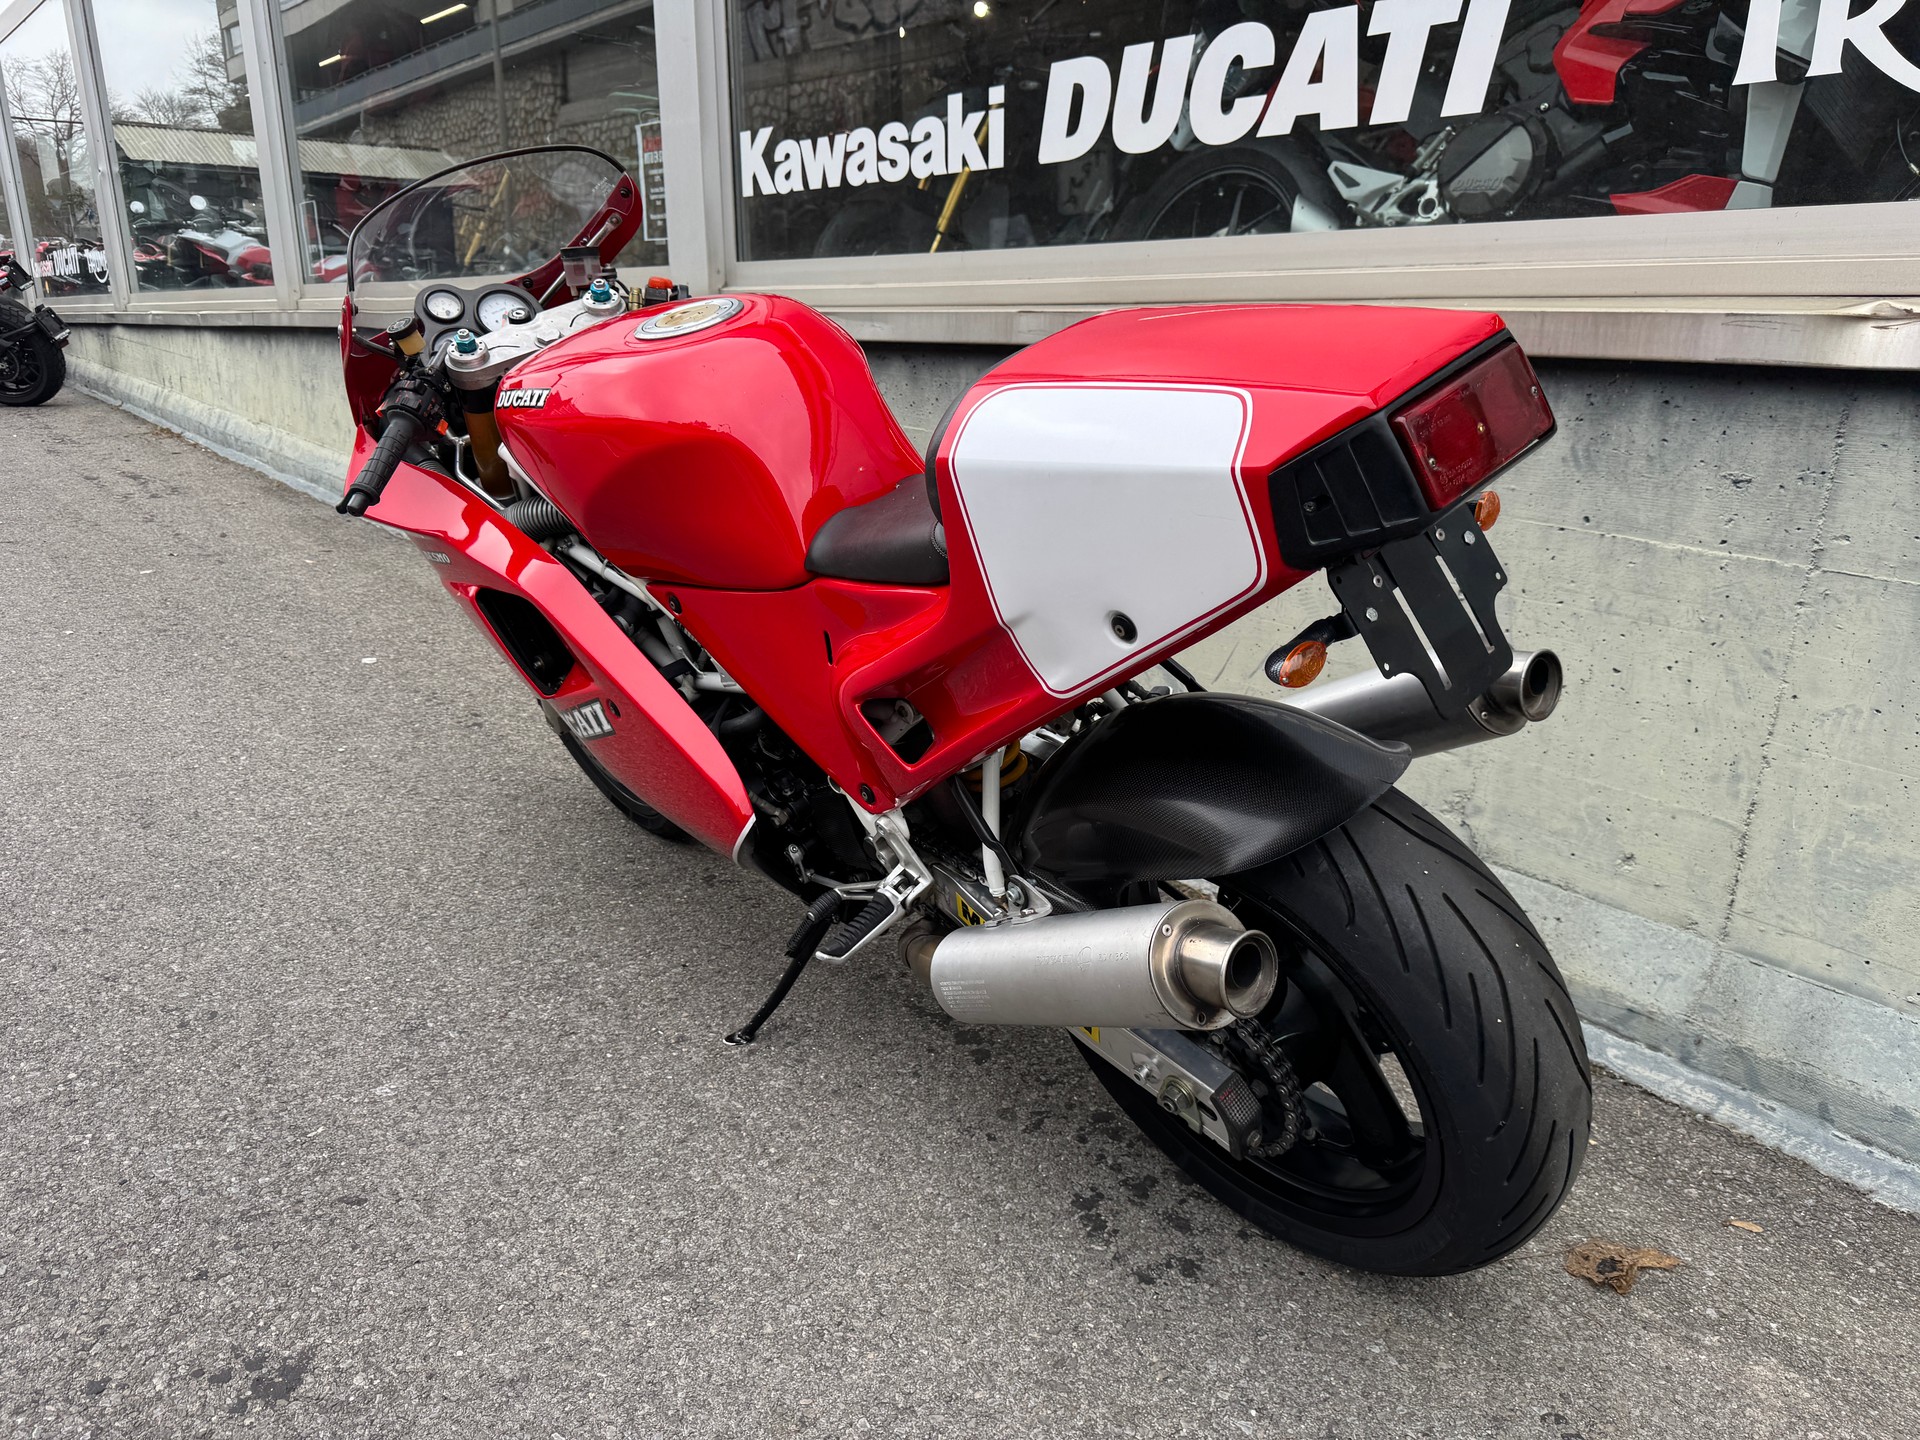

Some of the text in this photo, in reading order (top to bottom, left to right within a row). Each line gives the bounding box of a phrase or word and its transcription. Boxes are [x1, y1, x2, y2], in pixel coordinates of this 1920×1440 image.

[739, 84, 1005, 198] Kawasaki
[1038, 0, 1510, 165] DUCATI
[496, 388, 551, 409] DUCATI
